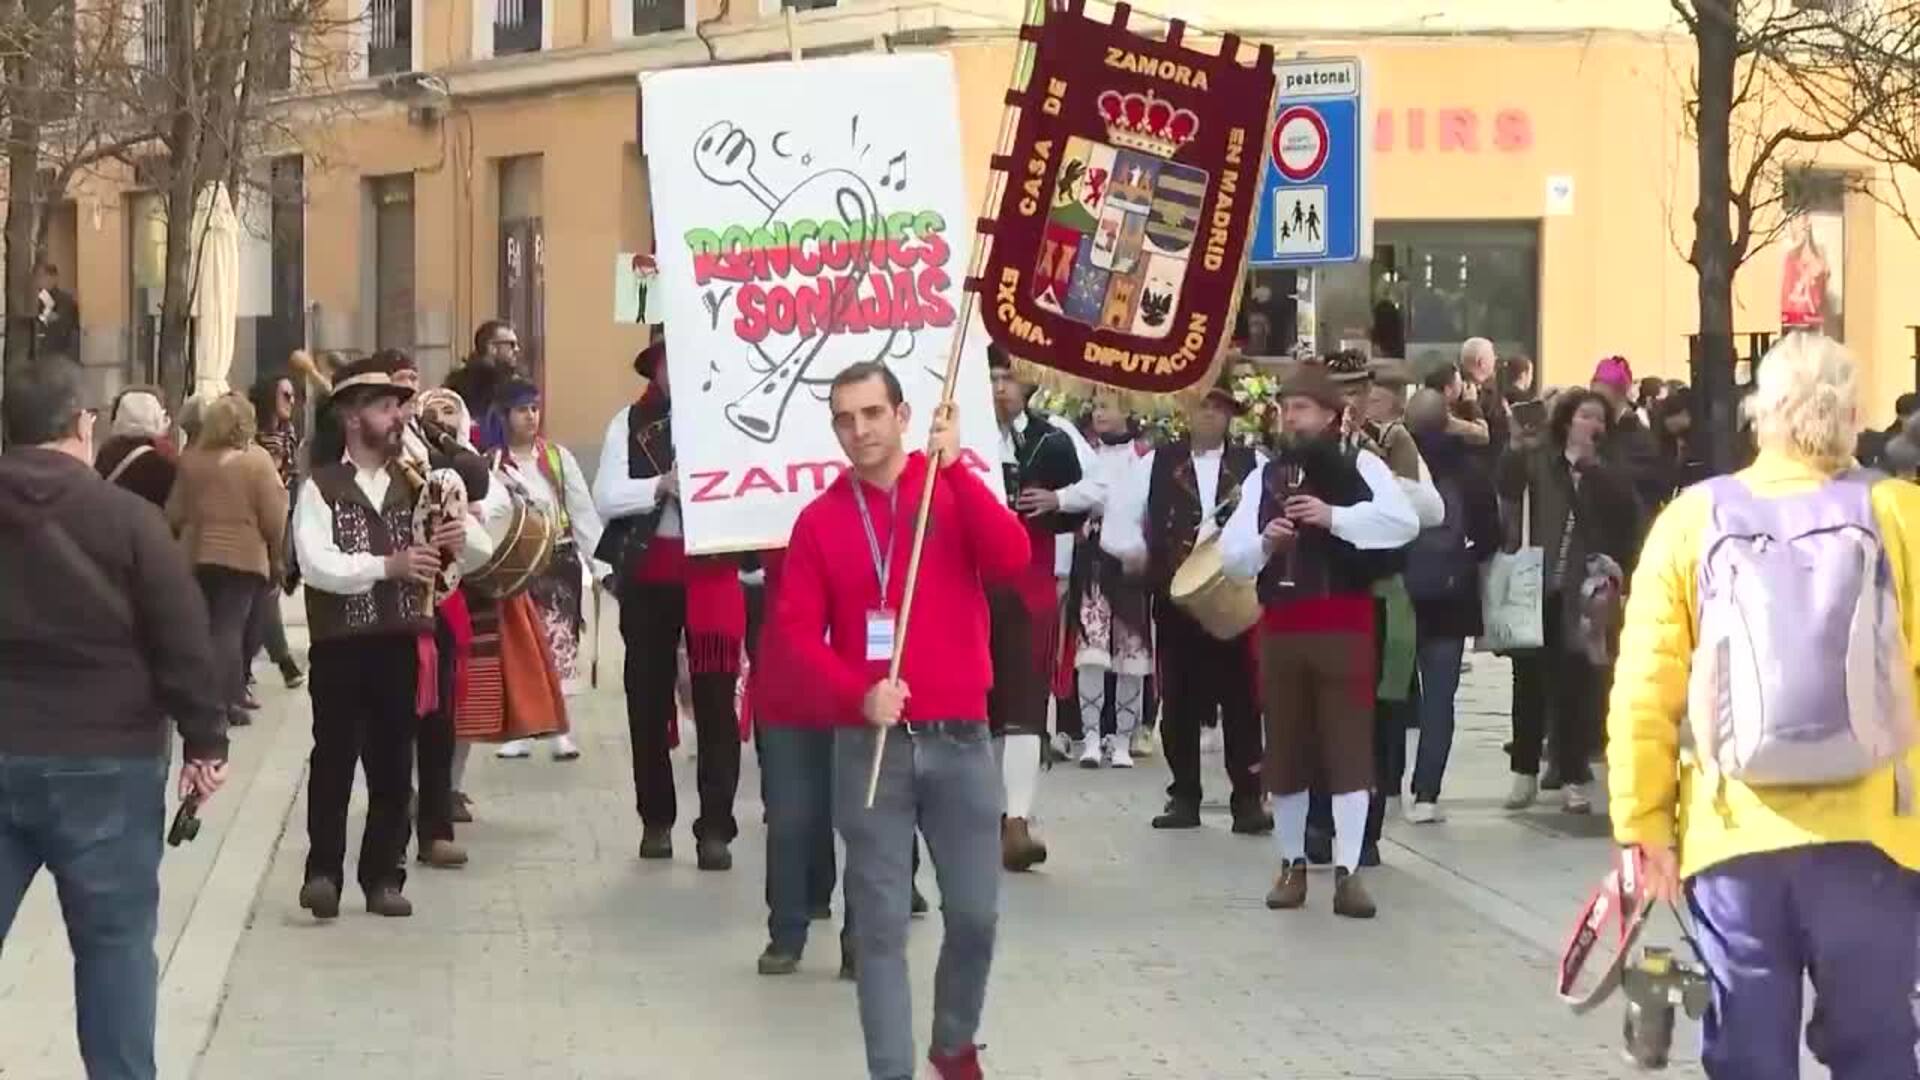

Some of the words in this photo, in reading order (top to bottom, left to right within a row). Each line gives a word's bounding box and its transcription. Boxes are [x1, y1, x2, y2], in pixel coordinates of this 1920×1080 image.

[1104, 47, 1209, 91] ZAMORA
[1286, 68, 1351, 89] peatonal
[1019, 139, 1053, 216] CASA
[1042, 77, 1068, 116] DE
[1225, 127, 1245, 164] EN
[684, 210, 950, 285] RONCONES
[1203, 169, 1239, 271] MADRID
[734, 267, 957, 343] SONAJAS
[997, 266, 1053, 346] EXCMA.
[1083, 312, 1208, 375] DIPUTACION
[689, 446, 991, 502] ZAMA
